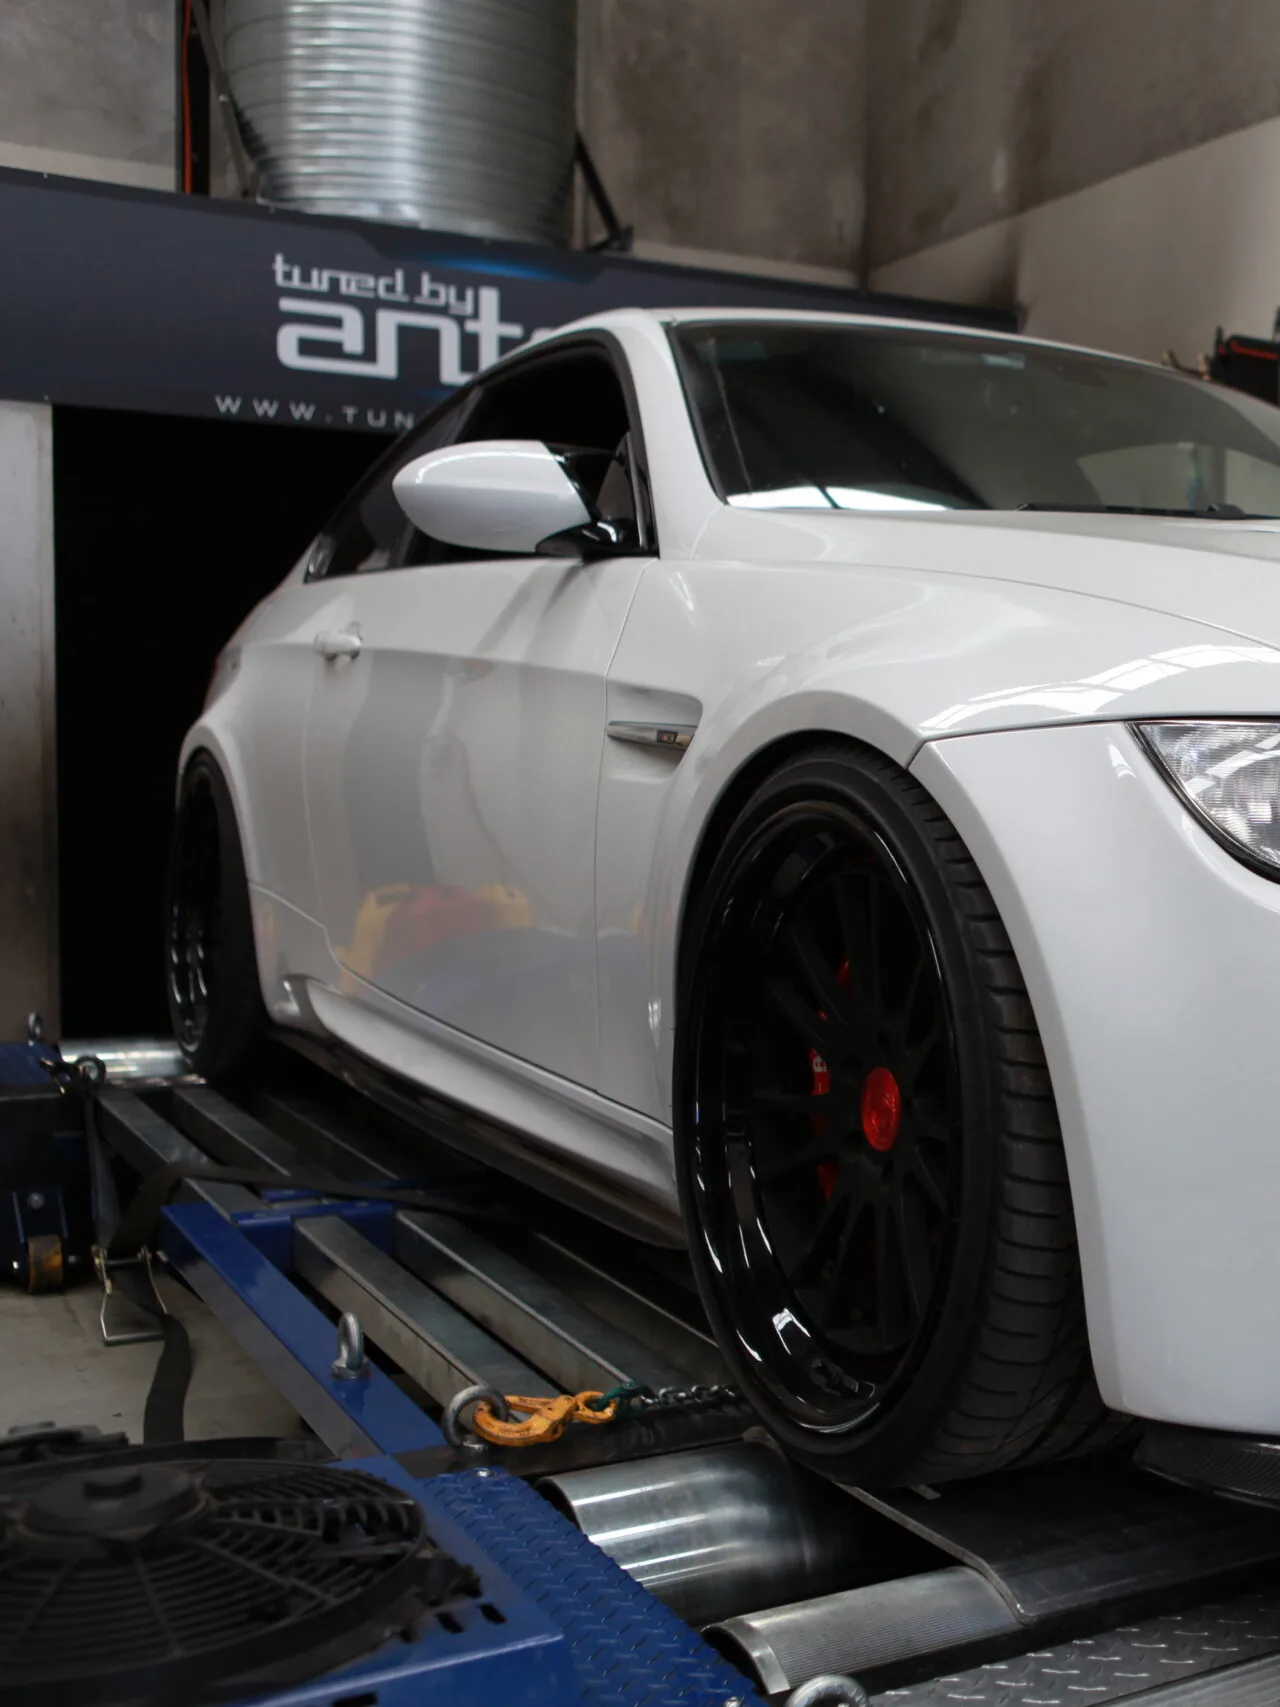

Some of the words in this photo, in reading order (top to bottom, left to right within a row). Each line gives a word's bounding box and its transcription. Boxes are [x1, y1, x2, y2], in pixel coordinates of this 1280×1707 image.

[273, 253, 409, 301] tuned
[413, 271, 475, 316] by
[277, 285, 556, 387] ant
